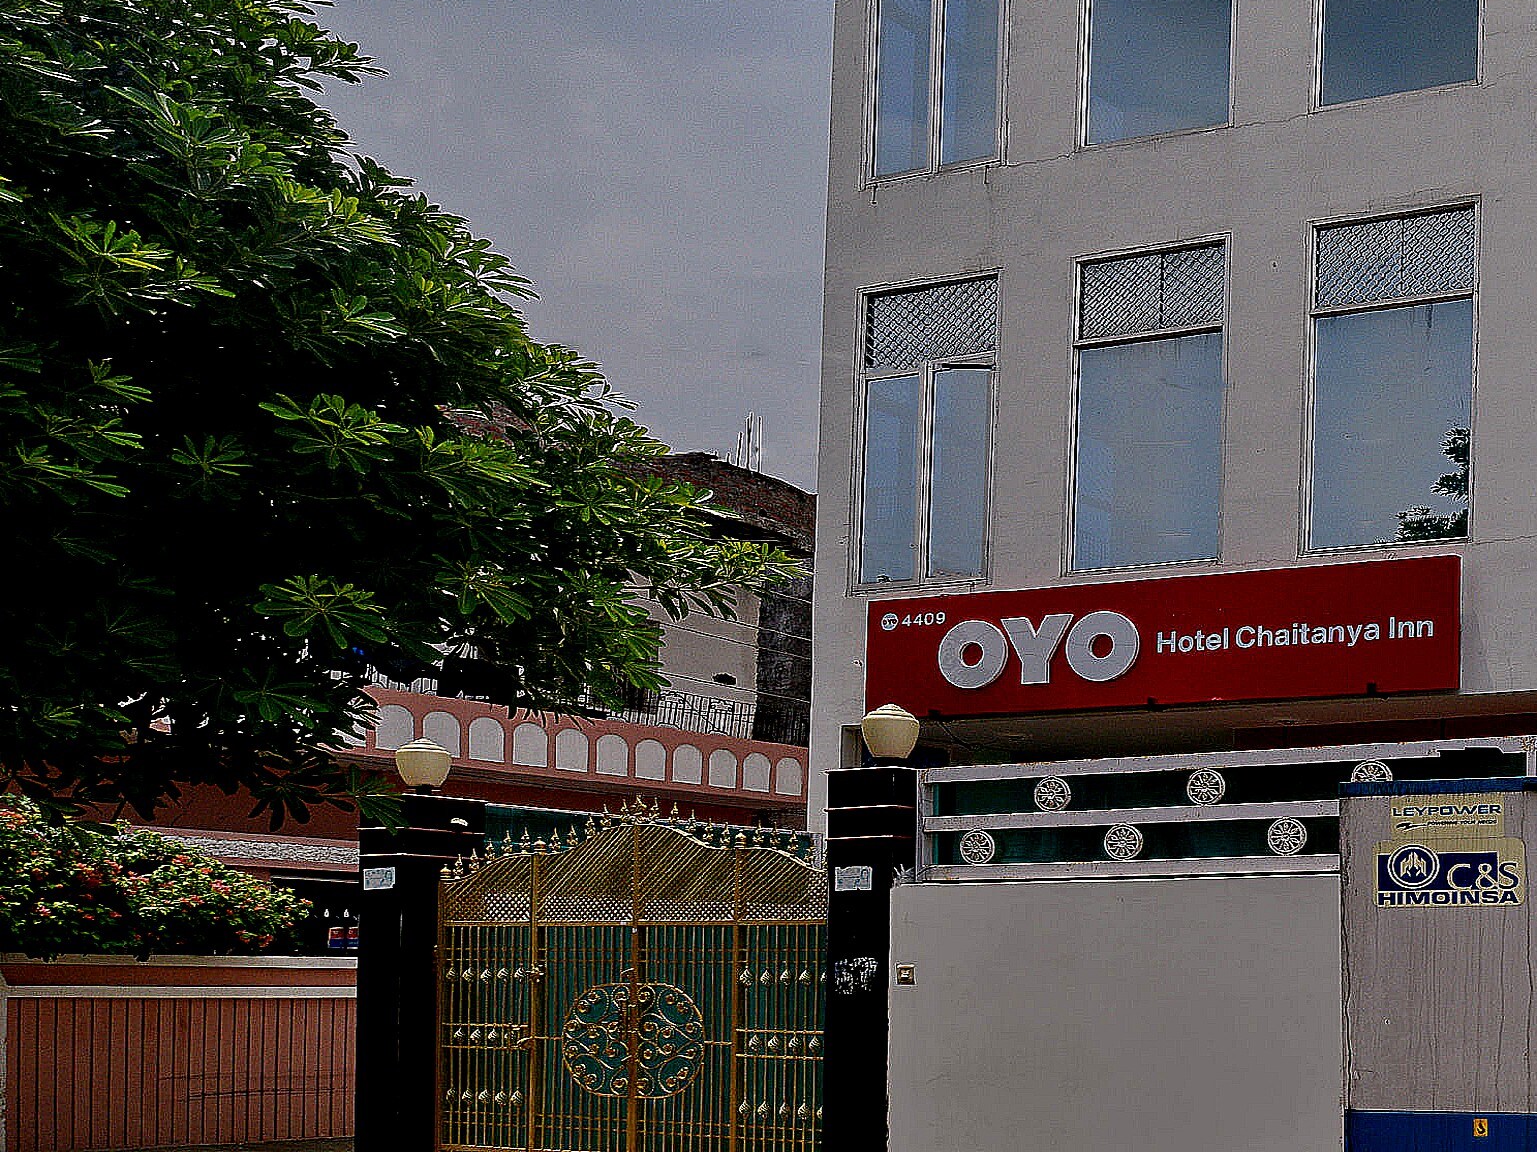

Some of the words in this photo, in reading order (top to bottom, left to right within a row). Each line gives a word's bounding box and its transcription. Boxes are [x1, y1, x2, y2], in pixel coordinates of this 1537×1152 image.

[901, 612, 946, 627] 4409
[1156, 627, 1230, 654] Hotel
[1235, 622, 1380, 648] Chaitanya
[1388, 616, 1434, 639] Inn
[938, 610, 1140, 689] OYO
[1392, 804, 1502, 817] LEYPOWER
[1447, 861, 1519, 890] C&S
[1378, 890, 1519, 906] HIMOINSA
